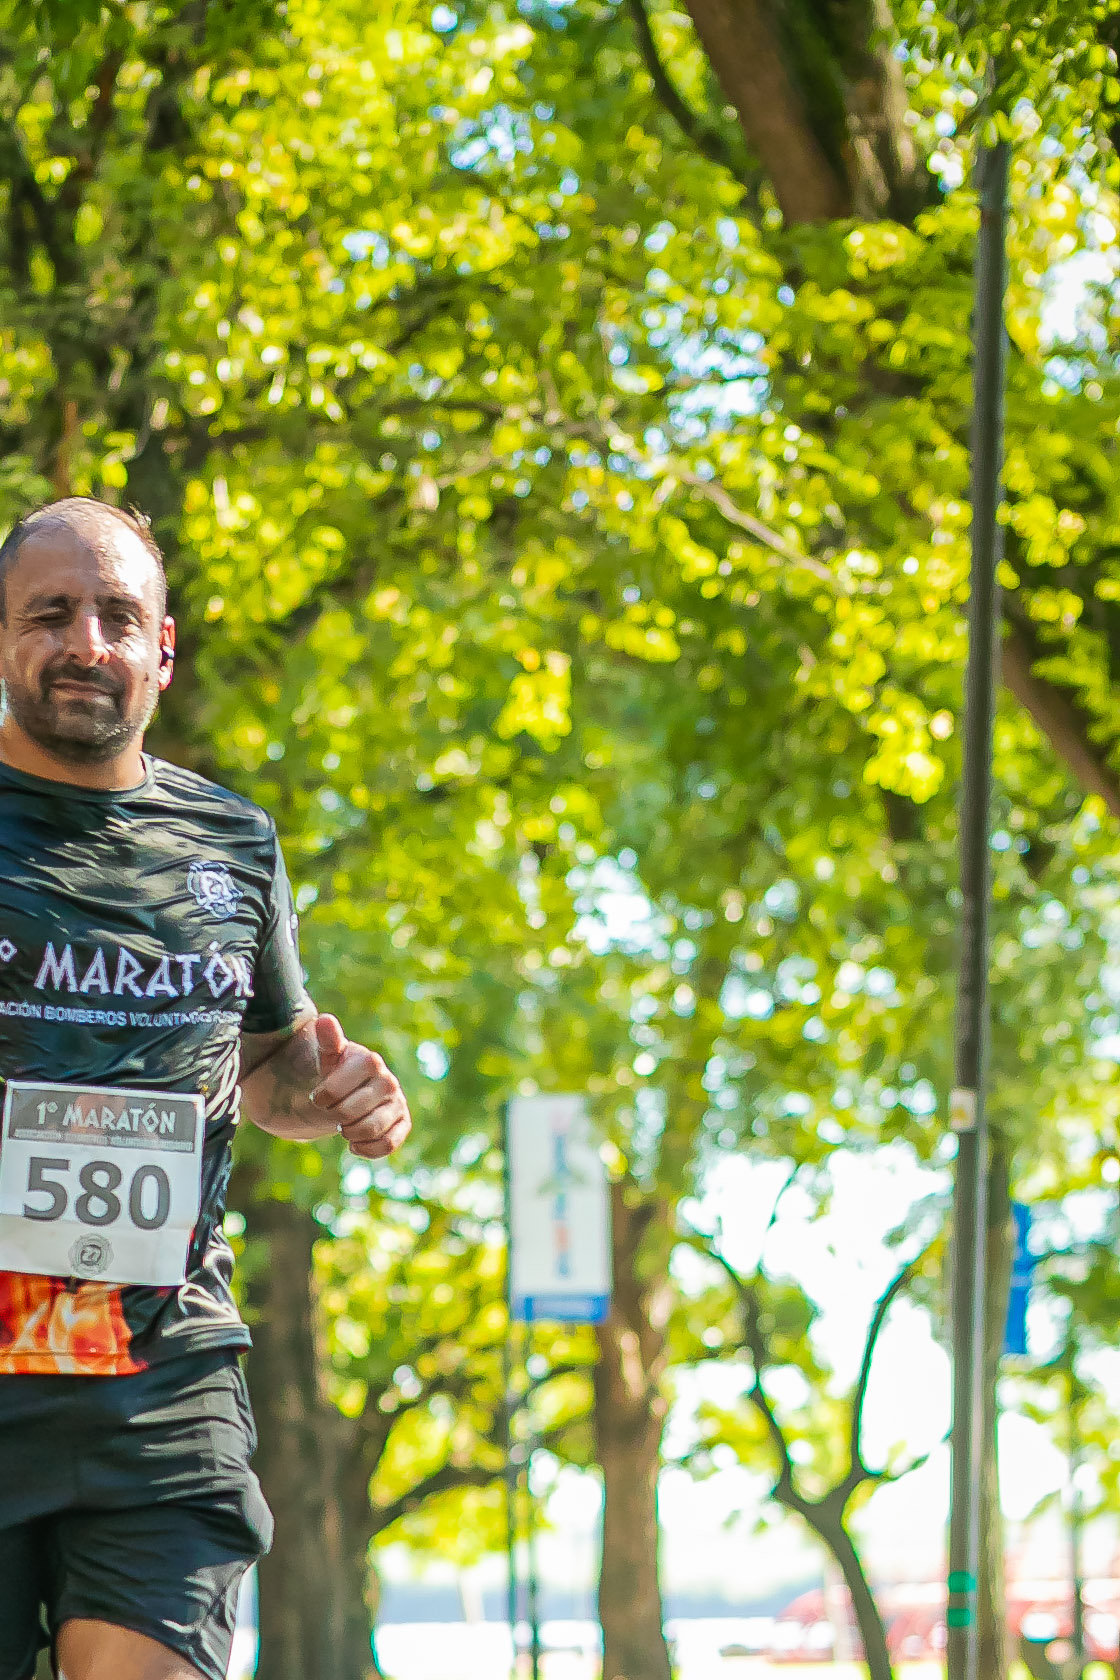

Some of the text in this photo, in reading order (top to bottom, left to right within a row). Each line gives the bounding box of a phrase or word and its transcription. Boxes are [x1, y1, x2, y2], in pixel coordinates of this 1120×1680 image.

[33, 940, 254, 999] MARATÓN
[44, 1005, 127, 1027] BOMBEROS
[62, 1102, 176, 1135] MARATÓN
[23, 1157, 171, 1230] 580
